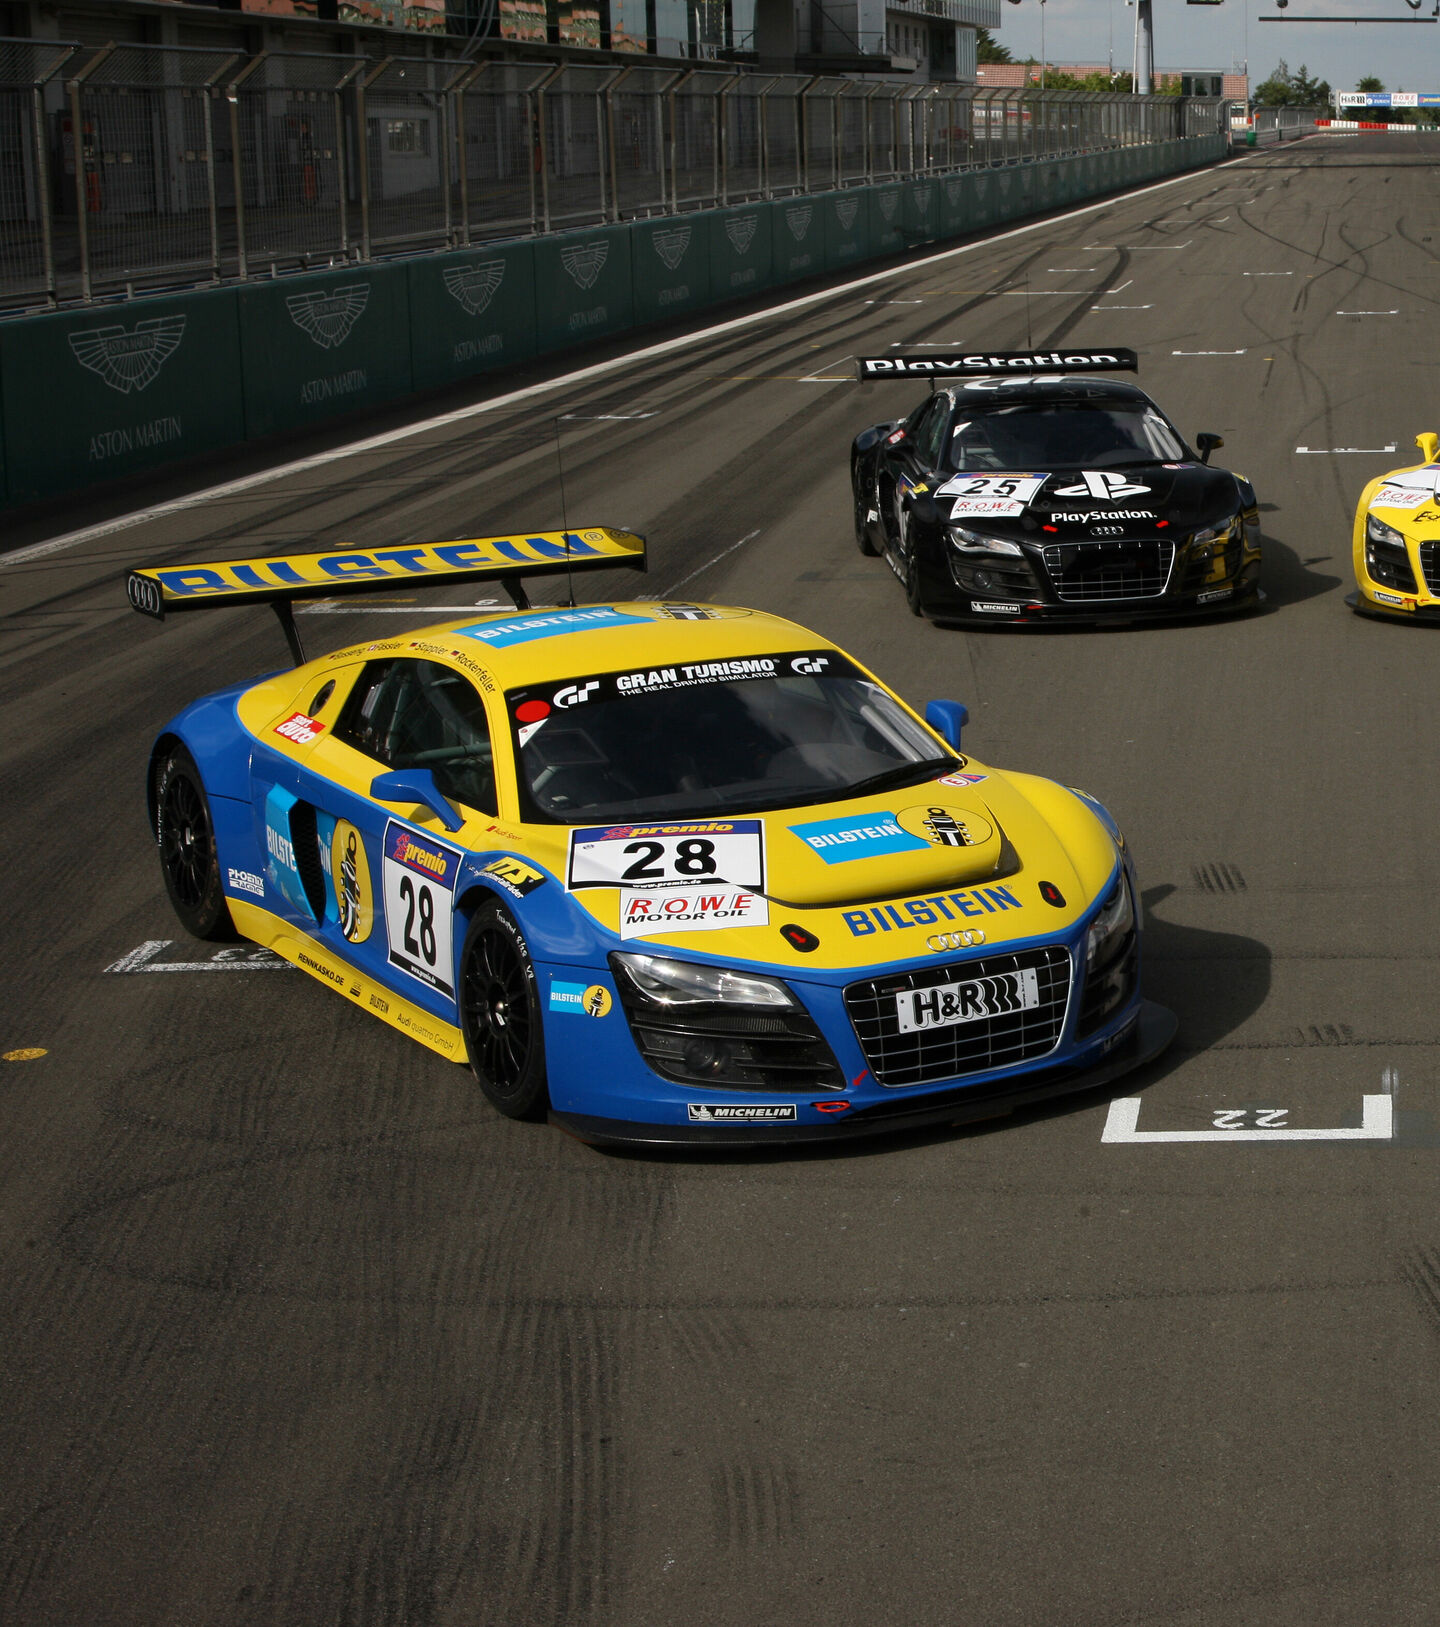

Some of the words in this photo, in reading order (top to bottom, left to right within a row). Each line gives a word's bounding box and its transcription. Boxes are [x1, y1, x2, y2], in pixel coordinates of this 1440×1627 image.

[454, 339, 478, 362] ASTON
[478, 334, 503, 354] MARTIN
[865, 353, 1118, 372] PlayStation
[301, 380, 333, 403] ASTON
[334, 368, 367, 395] MARTIN
[88, 430, 134, 461] ASTON
[135, 415, 183, 447] MARTIN
[962, 479, 1022, 496] 25
[1378, 489, 1428, 502] ROWE
[1051, 508, 1153, 524] PlayStation
[157, 533, 603, 597] BILSTEIN
[982, 604, 1019, 613] MICHELIN
[473, 607, 618, 640] BILSTEIN
[416, 641, 448, 656] Stippler
[455, 652, 496, 694] Rockenfeller
[616, 669, 678, 691] GRAN
[681, 658, 776, 681] TURISMO
[619, 688, 643, 698] THE
[644, 683, 673, 693] REAL
[673, 677, 718, 689] DRIVING
[718, 671, 778, 683] SIMULATOR
[276, 721, 316, 743] auto
[629, 822, 734, 838] premio
[807, 824, 904, 849] BILSTEIN
[404, 841, 447, 876] premio
[621, 838, 717, 880] 28
[632, 879, 702, 889] www.premio.de
[626, 911, 705, 924] MOTOR
[714, 908, 748, 918] OIL
[627, 894, 755, 915] ROWE
[841, 885, 1024, 937] BILSTEIN
[400, 875, 436, 967] 28
[298, 952, 345, 986] RENNKASKO.DE
[369, 993, 389, 1014] BILSTEIN
[550, 991, 582, 1003] BILSTEIN
[914, 977, 1002, 1027] H&R
[397, 1013, 411, 1027] Audi
[411, 1022, 435, 1041] quattro
[434, 1033, 454, 1051] GmbH
[713, 1106, 793, 1118] MICHELIN
[1212, 1109, 1289, 1129] 22
